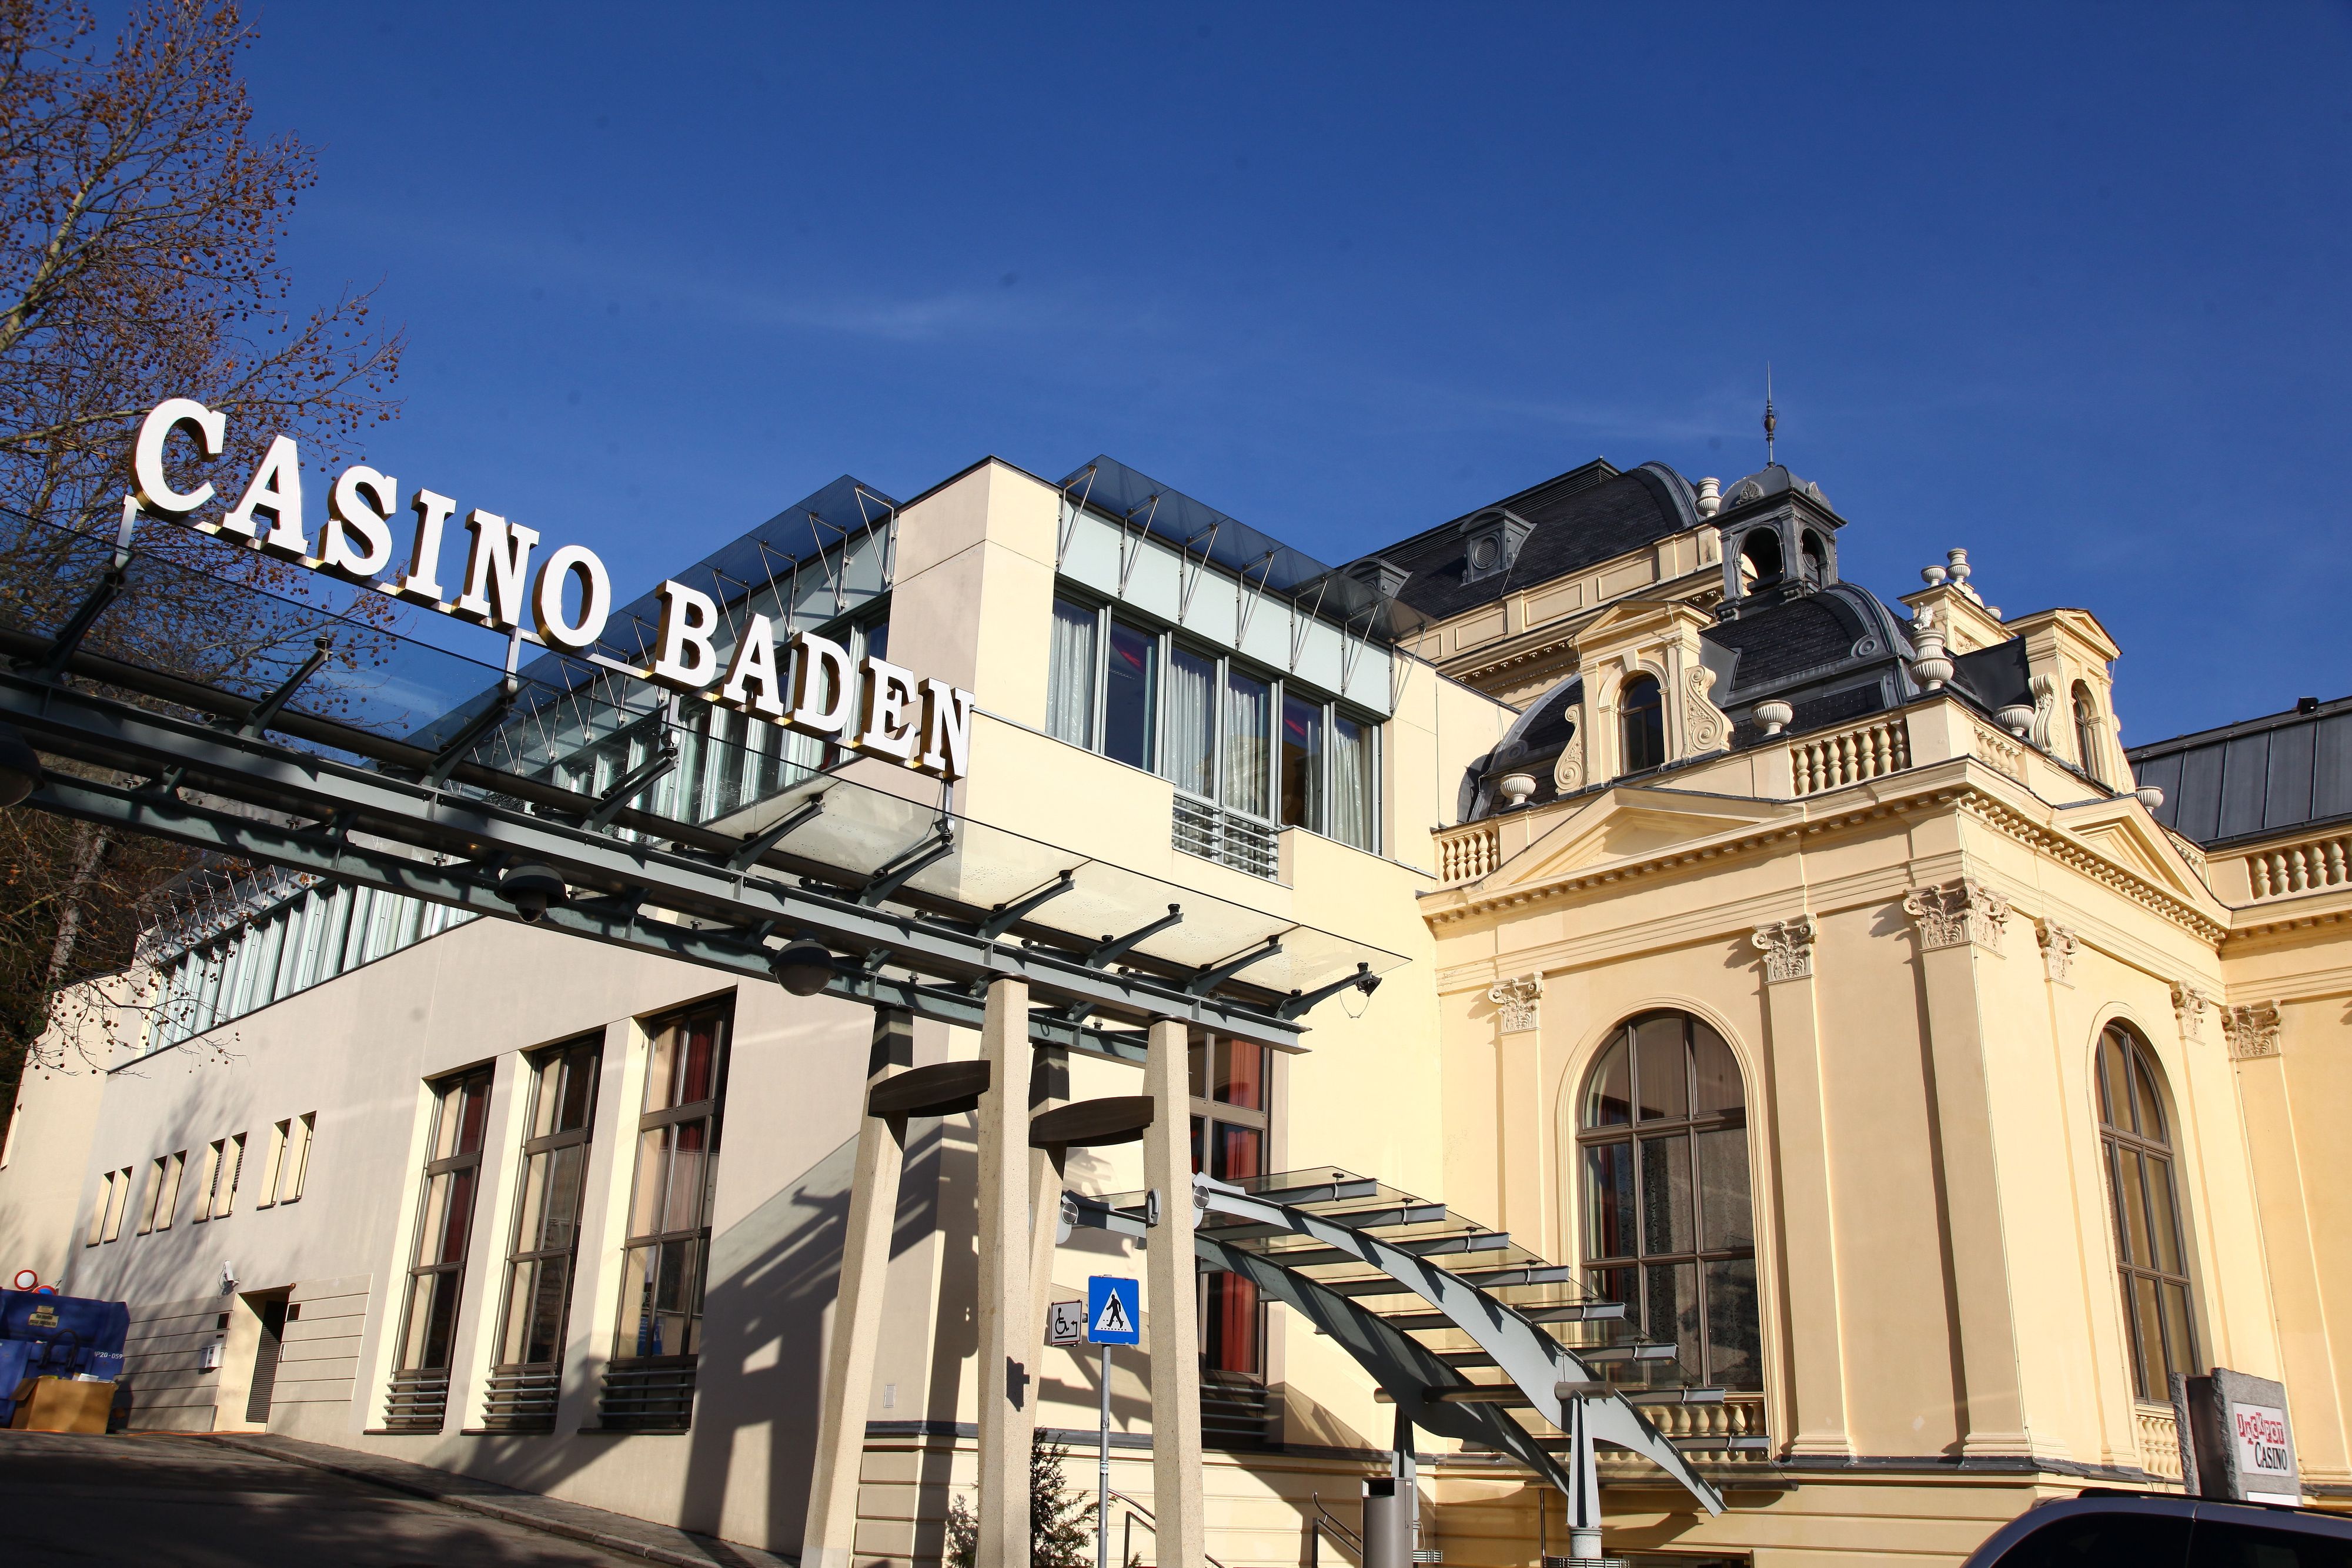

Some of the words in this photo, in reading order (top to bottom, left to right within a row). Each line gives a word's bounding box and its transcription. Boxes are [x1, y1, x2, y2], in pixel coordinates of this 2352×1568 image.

[131, 398, 611, 651] CASINO
[653, 579, 975, 781] BADEN
[2237, 1412, 2285, 1445] JACKPOT
[2255, 1442, 2287, 1470] CASINO
